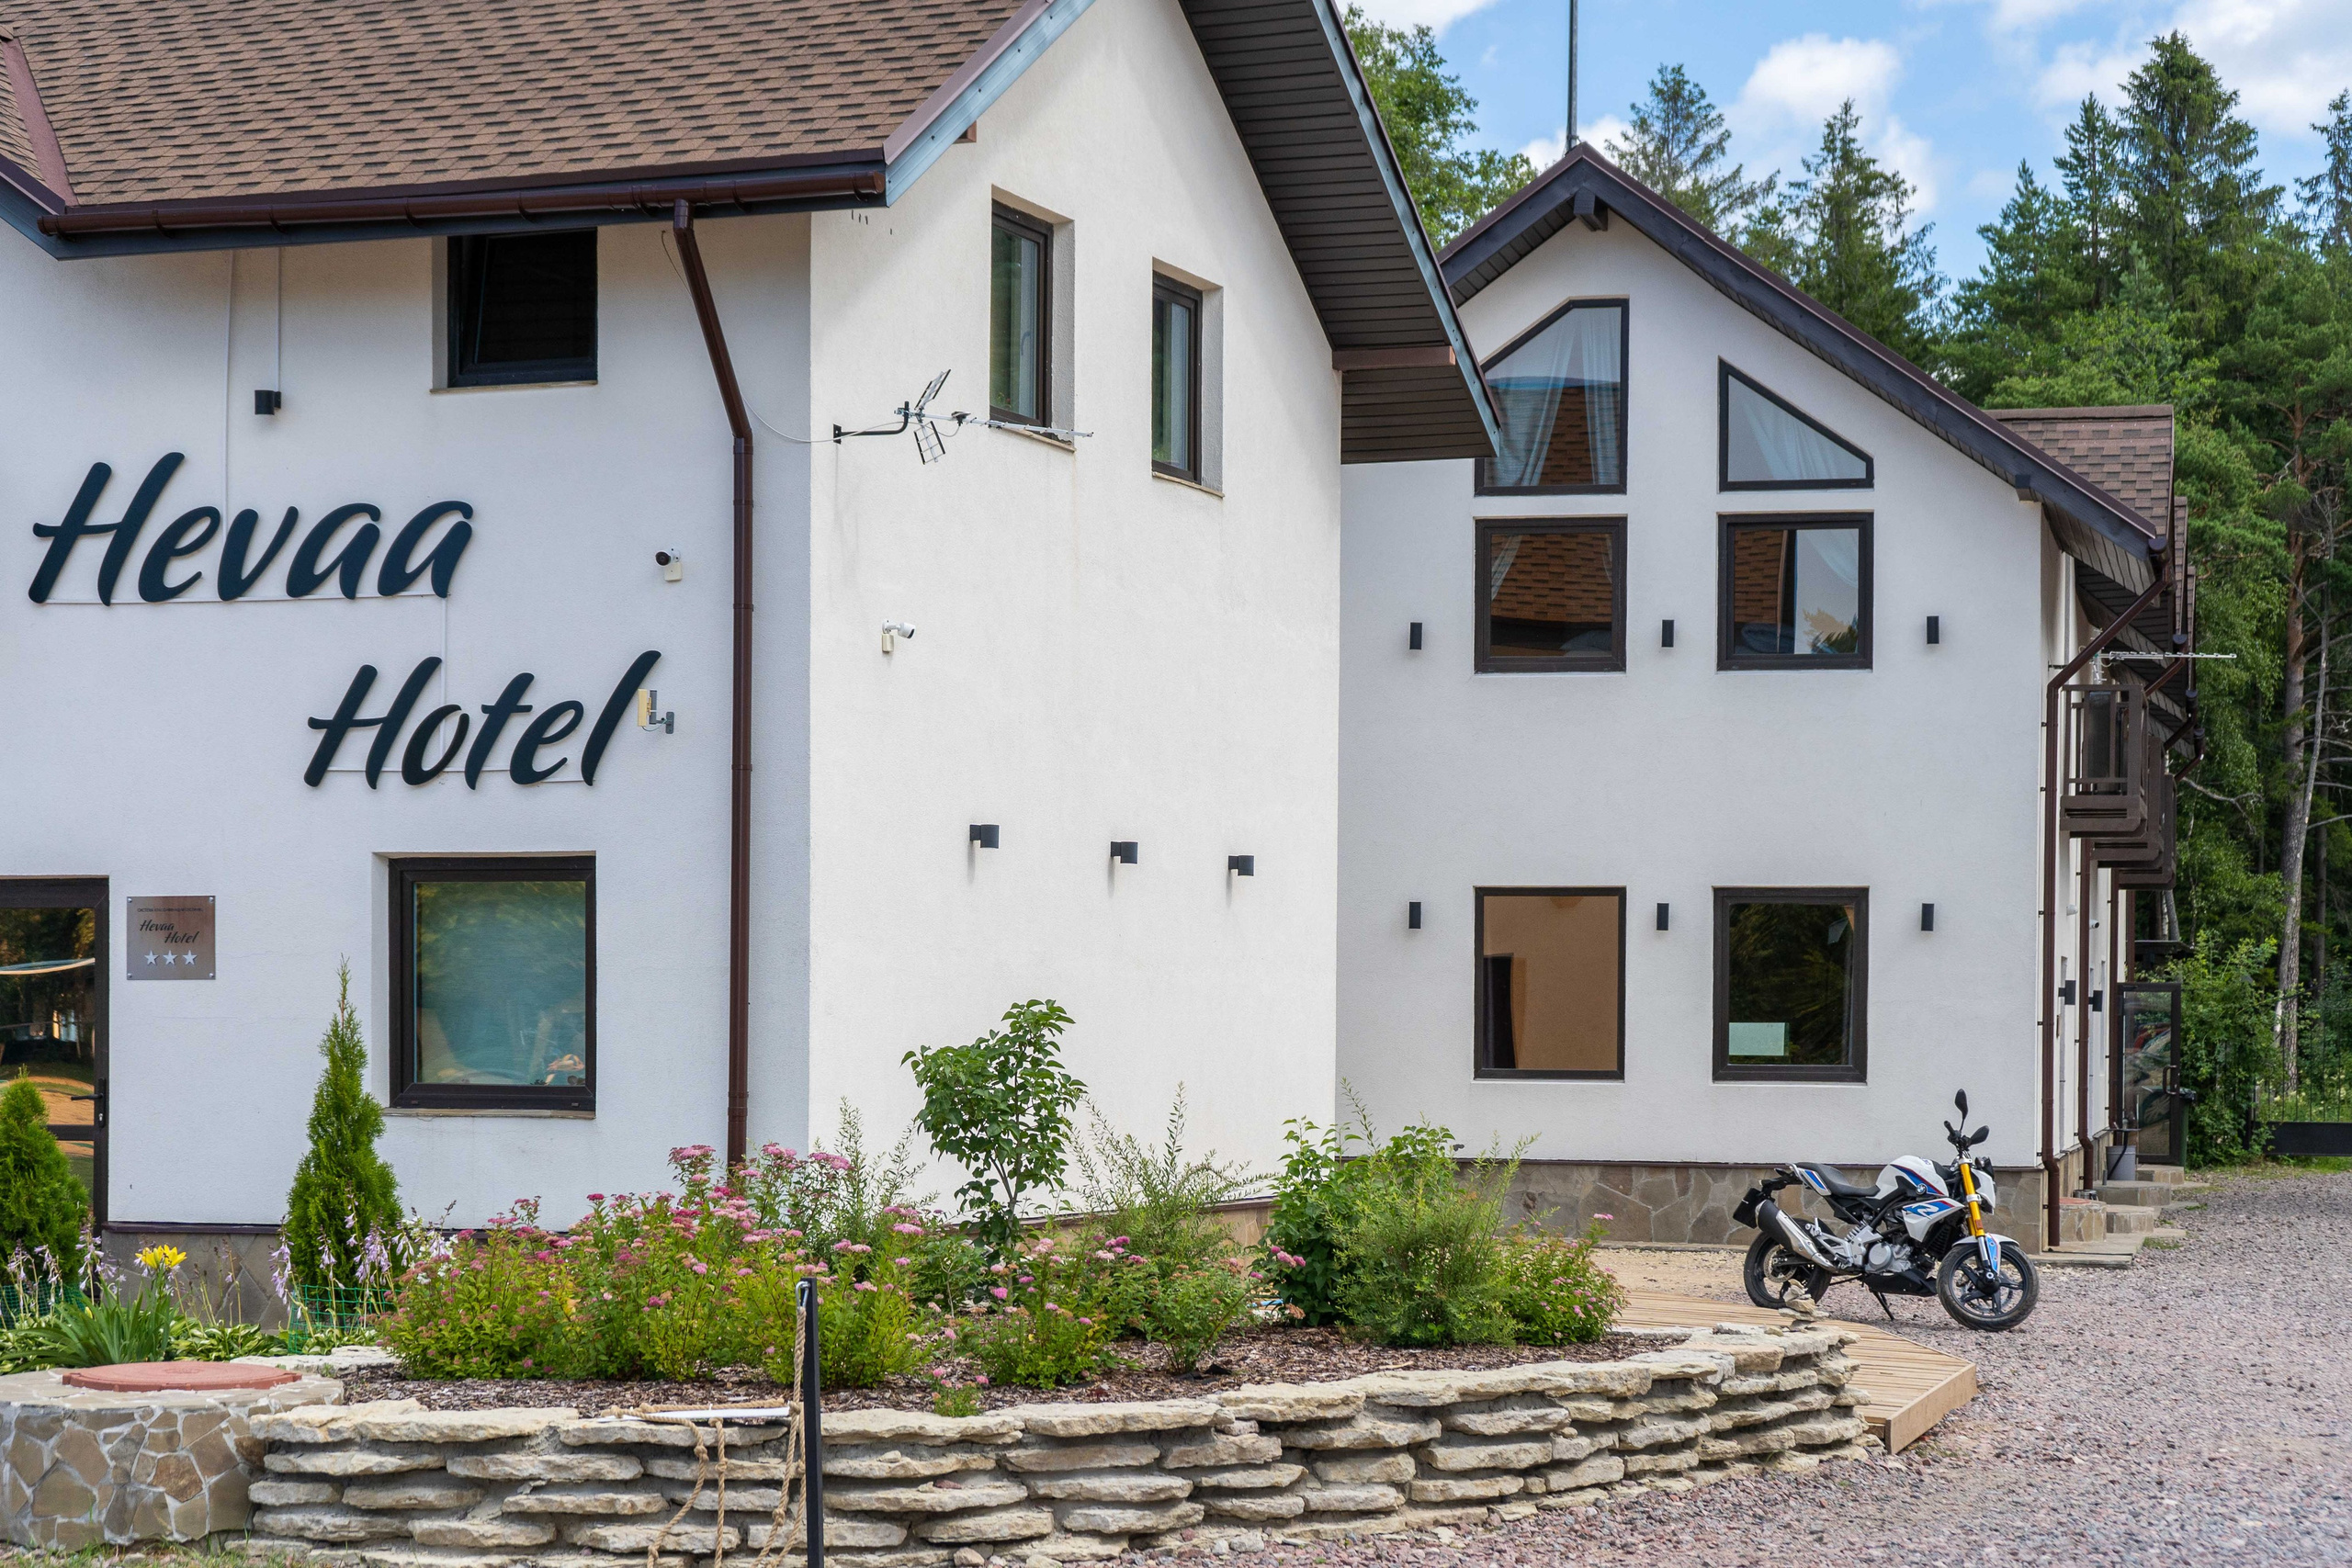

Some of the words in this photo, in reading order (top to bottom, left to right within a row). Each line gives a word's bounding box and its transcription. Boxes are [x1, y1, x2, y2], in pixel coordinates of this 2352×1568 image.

[28, 452, 474, 606] Hevaa
[304, 649, 662, 790] Hotel
[139, 919, 175, 931] Hevaa
[164, 931, 200, 943] Hotel
